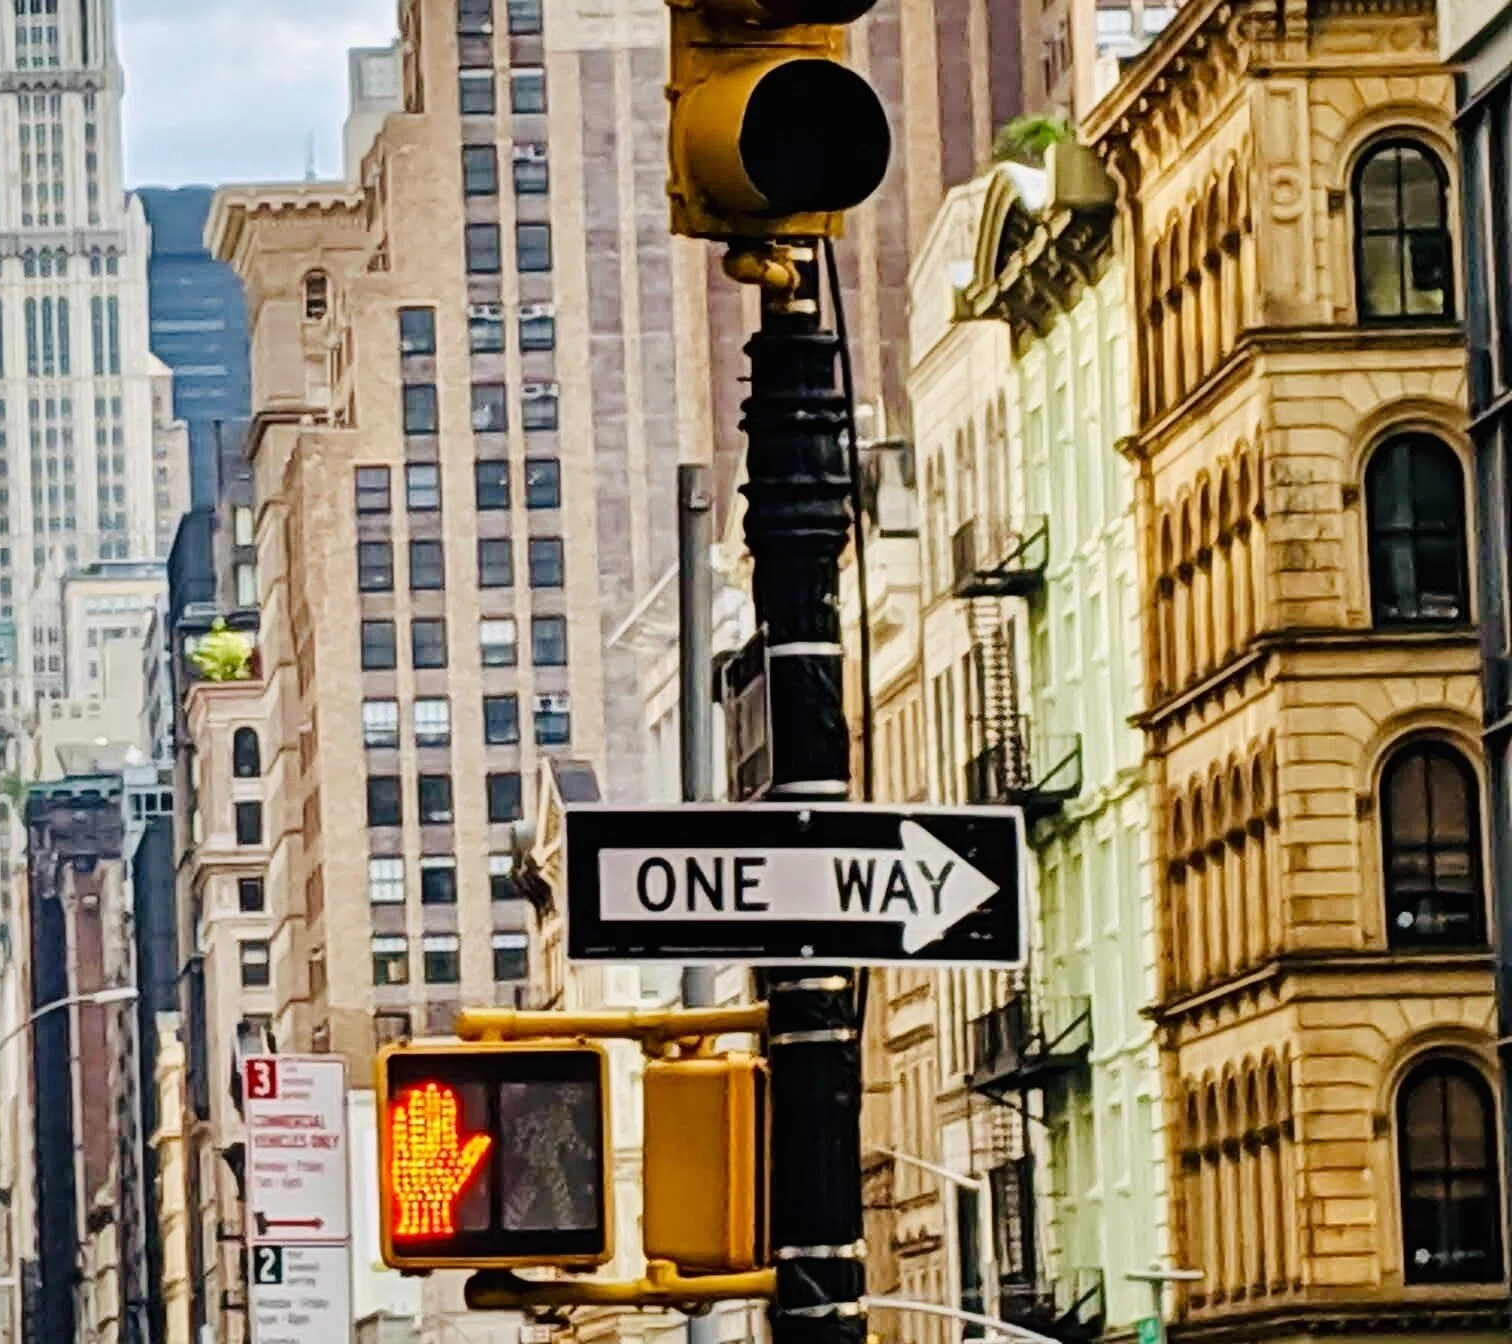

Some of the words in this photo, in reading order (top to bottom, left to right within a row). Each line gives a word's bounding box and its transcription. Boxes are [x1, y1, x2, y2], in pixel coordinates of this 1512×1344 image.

[636, 856, 770, 913] ONE
[833, 857, 957, 916] WAY
[252, 1062, 271, 1097] 3
[259, 1247, 277, 1282] 2
